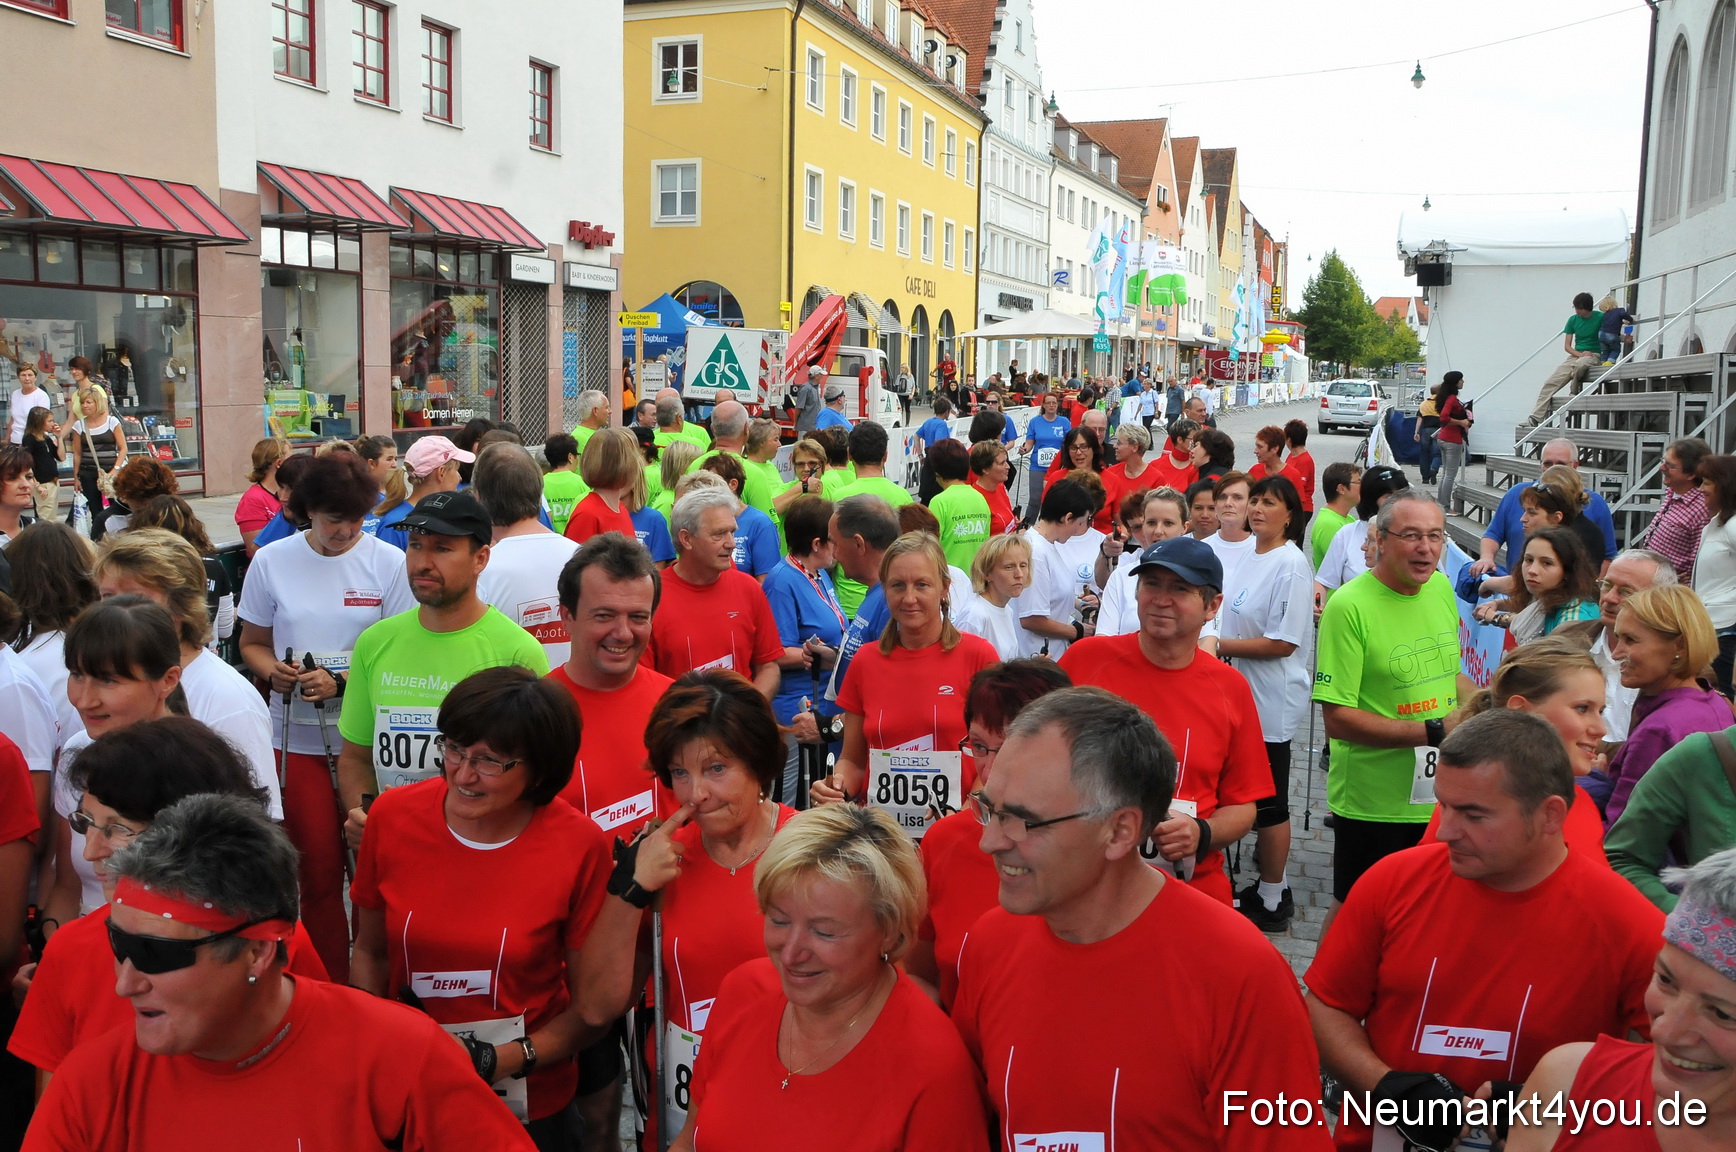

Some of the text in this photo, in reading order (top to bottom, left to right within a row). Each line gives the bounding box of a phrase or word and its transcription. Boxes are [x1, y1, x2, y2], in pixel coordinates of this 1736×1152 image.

[569, 220, 615, 250] Döpfer
[515, 264, 540, 273] GARDINEN
[571, 271, 582, 279] BABY
[586, 272, 616, 283] KINDERMODEN
[905, 275, 936, 299] CAFE DELI
[642, 333, 668, 343] Tagblatt
[423, 407, 474, 419] Damen Herren
[314, 656, 347, 666] BOCK
[1397, 698, 1439, 715] MERZ
[389, 713, 432, 724] BOCK
[890, 757, 930, 766] BOCK
[1424, 751, 1437, 778] 8
[876, 773, 949, 806] 8059
[610, 803, 637, 822] DEHN
[897, 812, 924, 827] Lisa
[432, 979, 469, 990] DEHN
[1443, 1035, 1485, 1050] DEHN
[674, 1063, 693, 1111] 8
